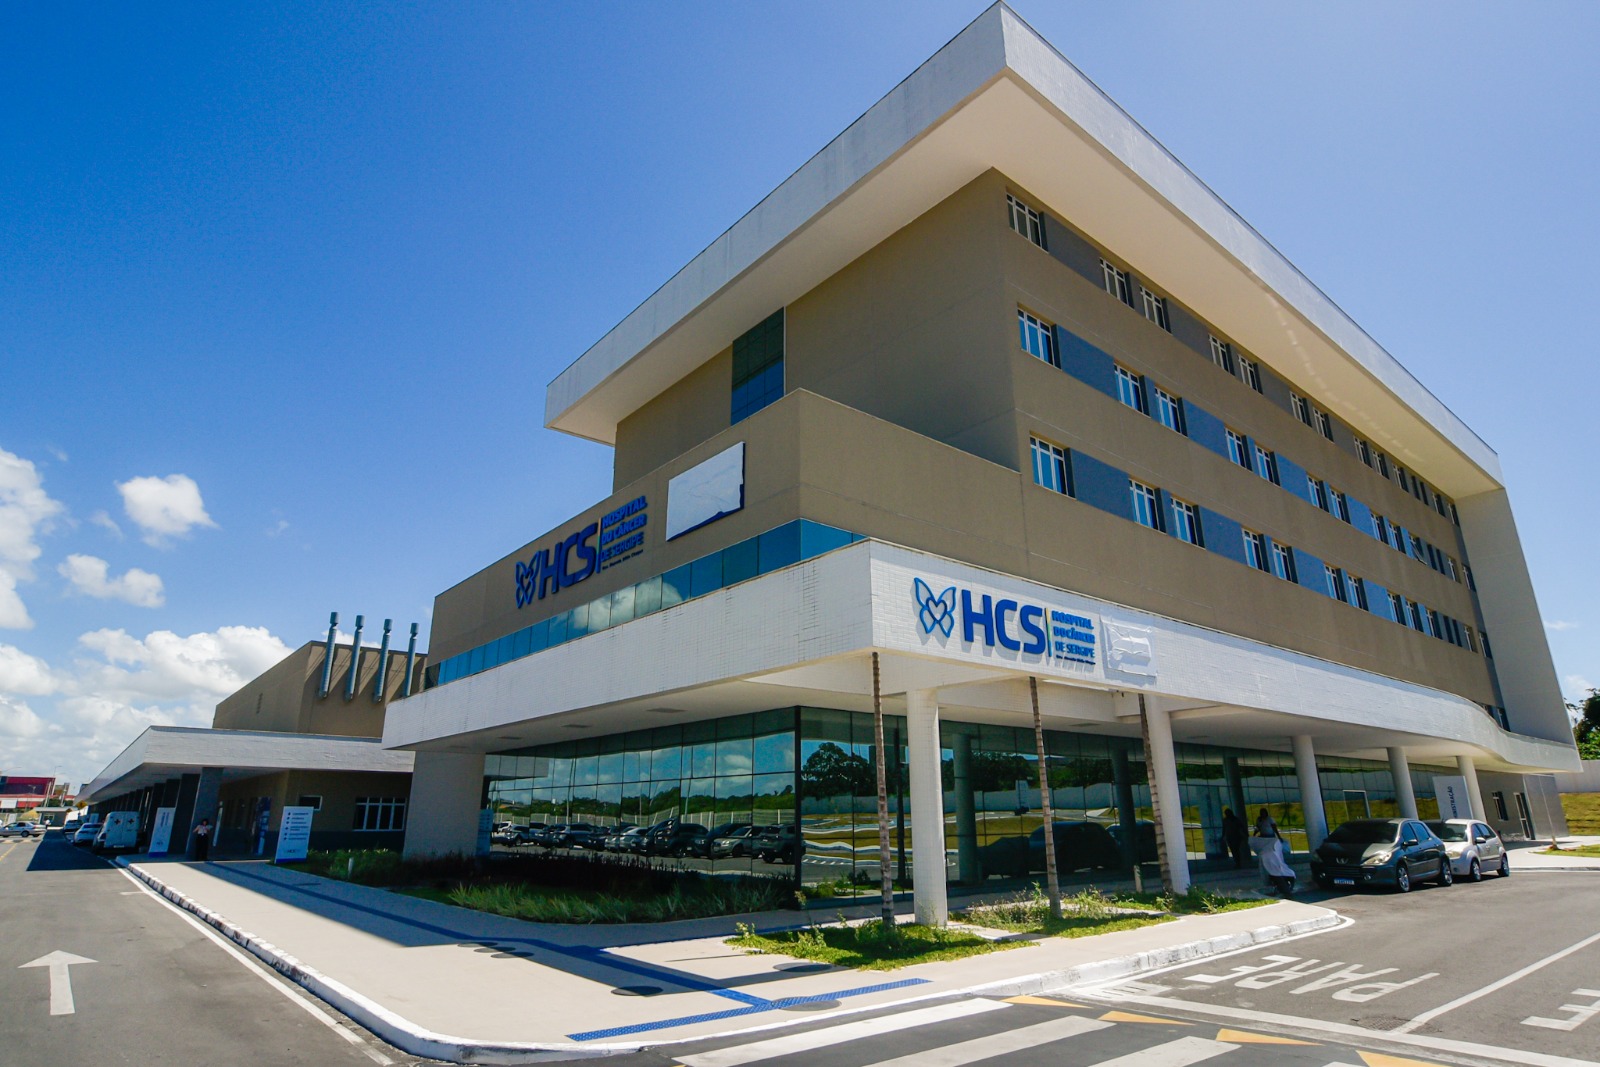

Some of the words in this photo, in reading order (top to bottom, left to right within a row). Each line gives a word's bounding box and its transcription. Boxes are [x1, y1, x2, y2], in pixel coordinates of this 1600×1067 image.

[602, 496, 648, 529] HOSPITAL
[602, 530, 614, 545] DO
[614, 513, 647, 539] CÂNCER
[538, 522, 598, 600] HCS
[601, 547, 612, 562] DE
[612, 531, 644, 557] SERGIPE
[961, 589, 1046, 657] HCS
[1051, 610, 1094, 629] HOSPITAL
[1053, 626, 1066, 638] DO
[1066, 627, 1095, 644] CÂNCER
[1055, 641, 1065, 652] DE
[1066, 643, 1095, 658] SERGIPE
[1182, 954, 1441, 1003] PARE
